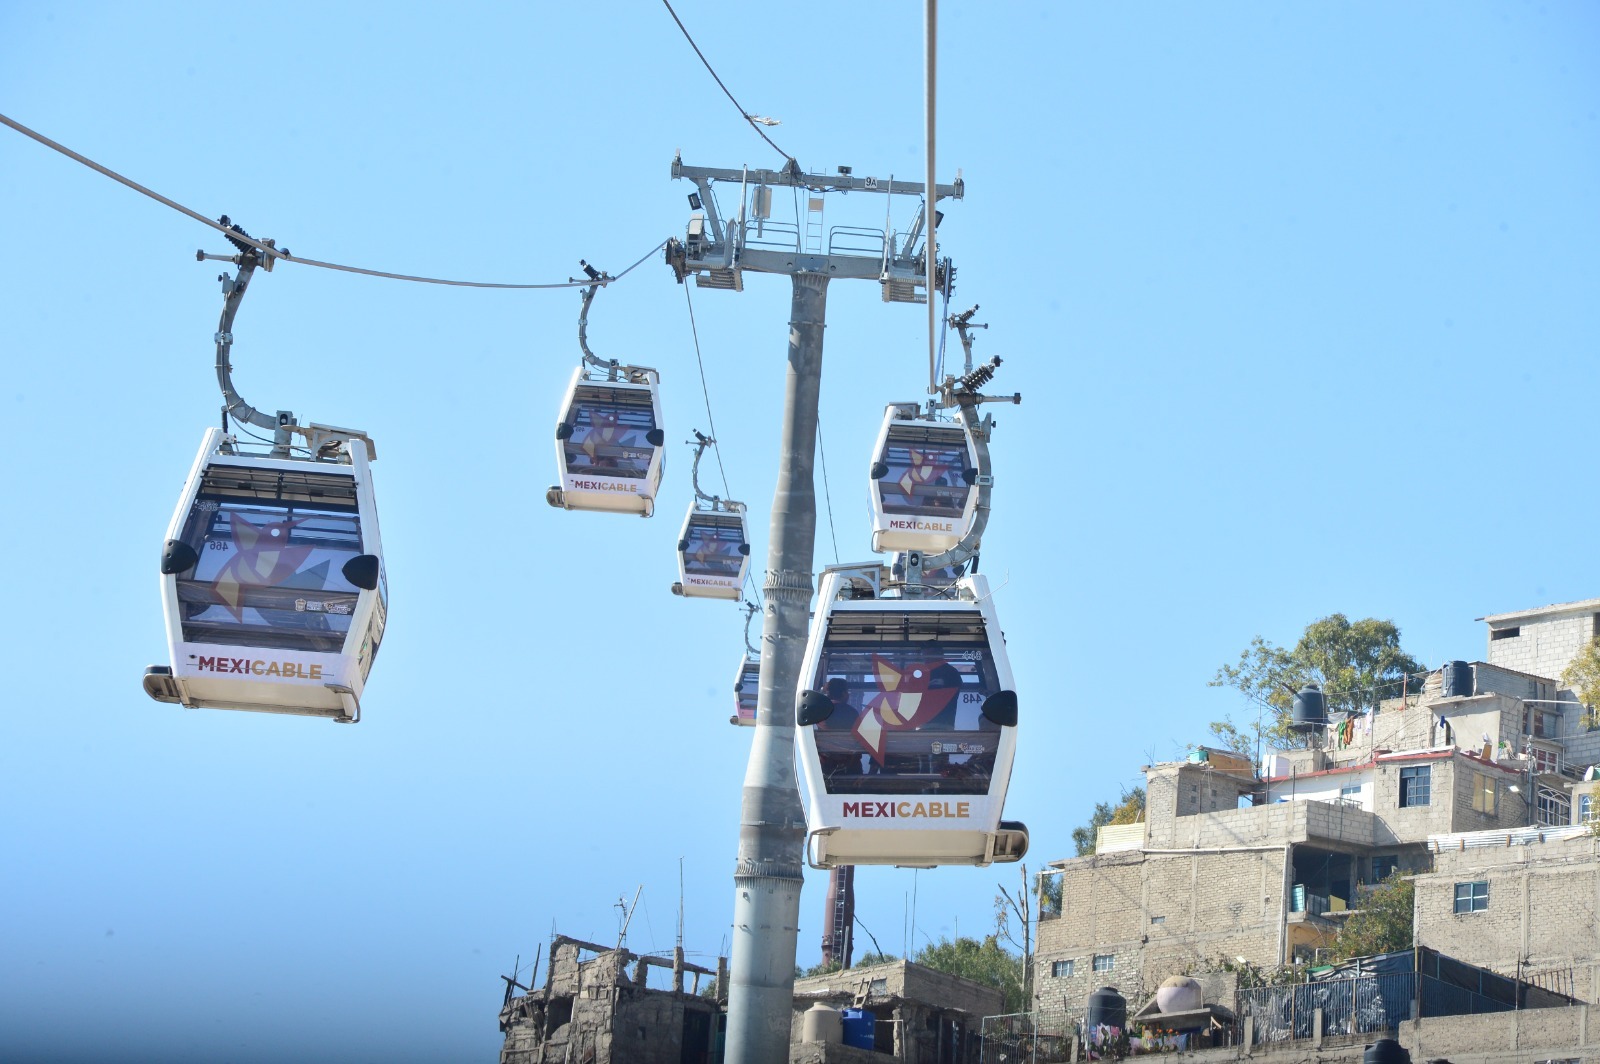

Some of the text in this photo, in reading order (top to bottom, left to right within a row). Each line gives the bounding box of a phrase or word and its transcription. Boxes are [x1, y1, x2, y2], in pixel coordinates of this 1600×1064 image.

[866, 177, 877, 187] 9A
[575, 481, 637, 493] MEXICABLE
[890, 520, 953, 532] MEXICABLE
[690, 578, 733, 587] MEXICABLE
[198, 656, 323, 680] MEXICABLE
[842, 801, 970, 818] MEXICABLE
